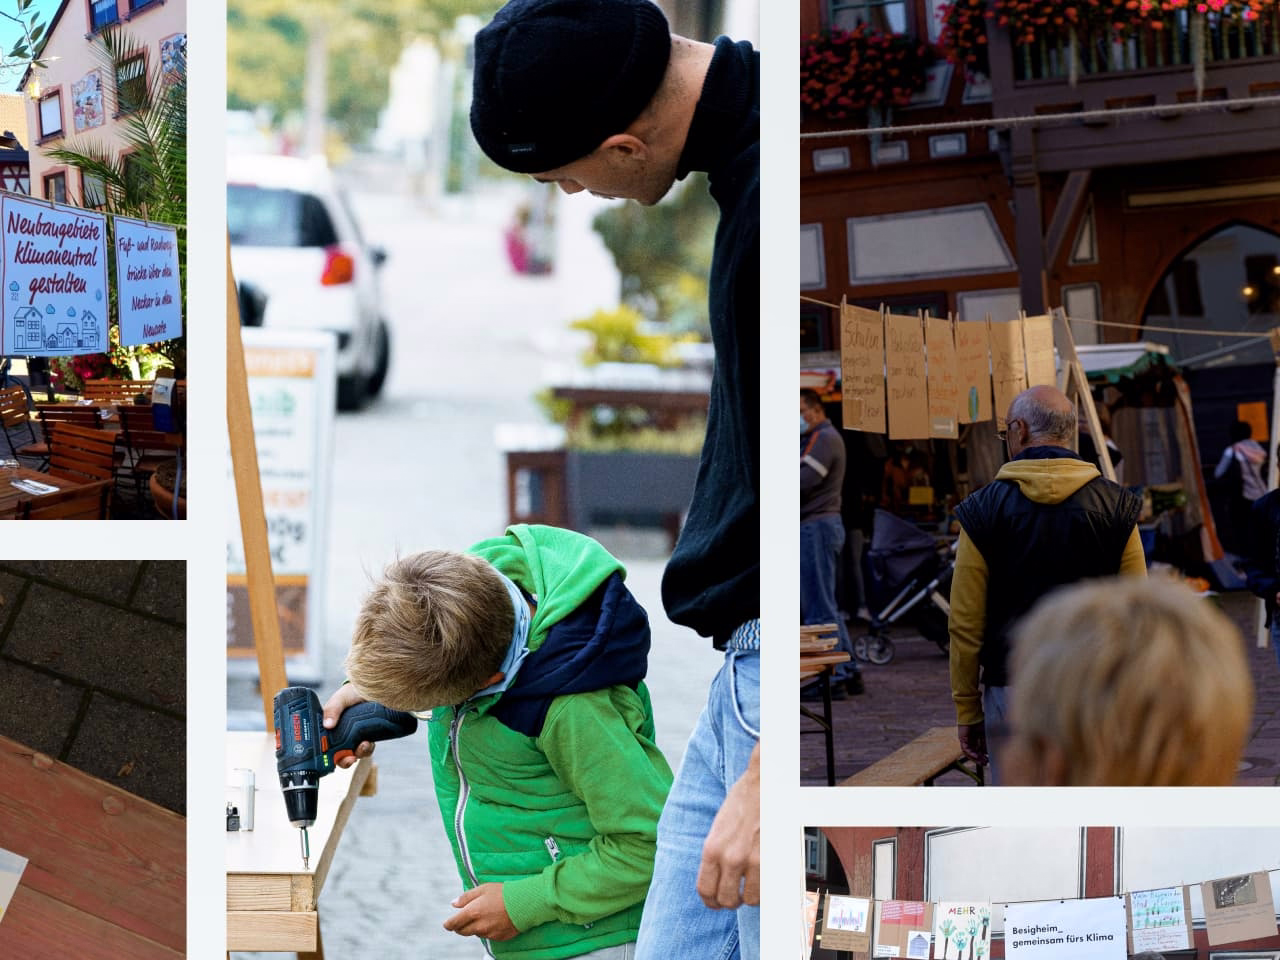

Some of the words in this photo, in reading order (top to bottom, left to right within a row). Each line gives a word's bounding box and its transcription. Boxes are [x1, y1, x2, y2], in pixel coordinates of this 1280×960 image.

[7, 211, 101, 249] Neubaugebiete
[28, 271, 87, 305] gestalten
[131, 294, 154, 312] Neckar
[948, 905, 976, 916] MEHR
[1012, 936, 1064, 949] gemeinsam
[1066, 934, 1084, 943] fürs
[1086, 933, 1114, 942] Klima
